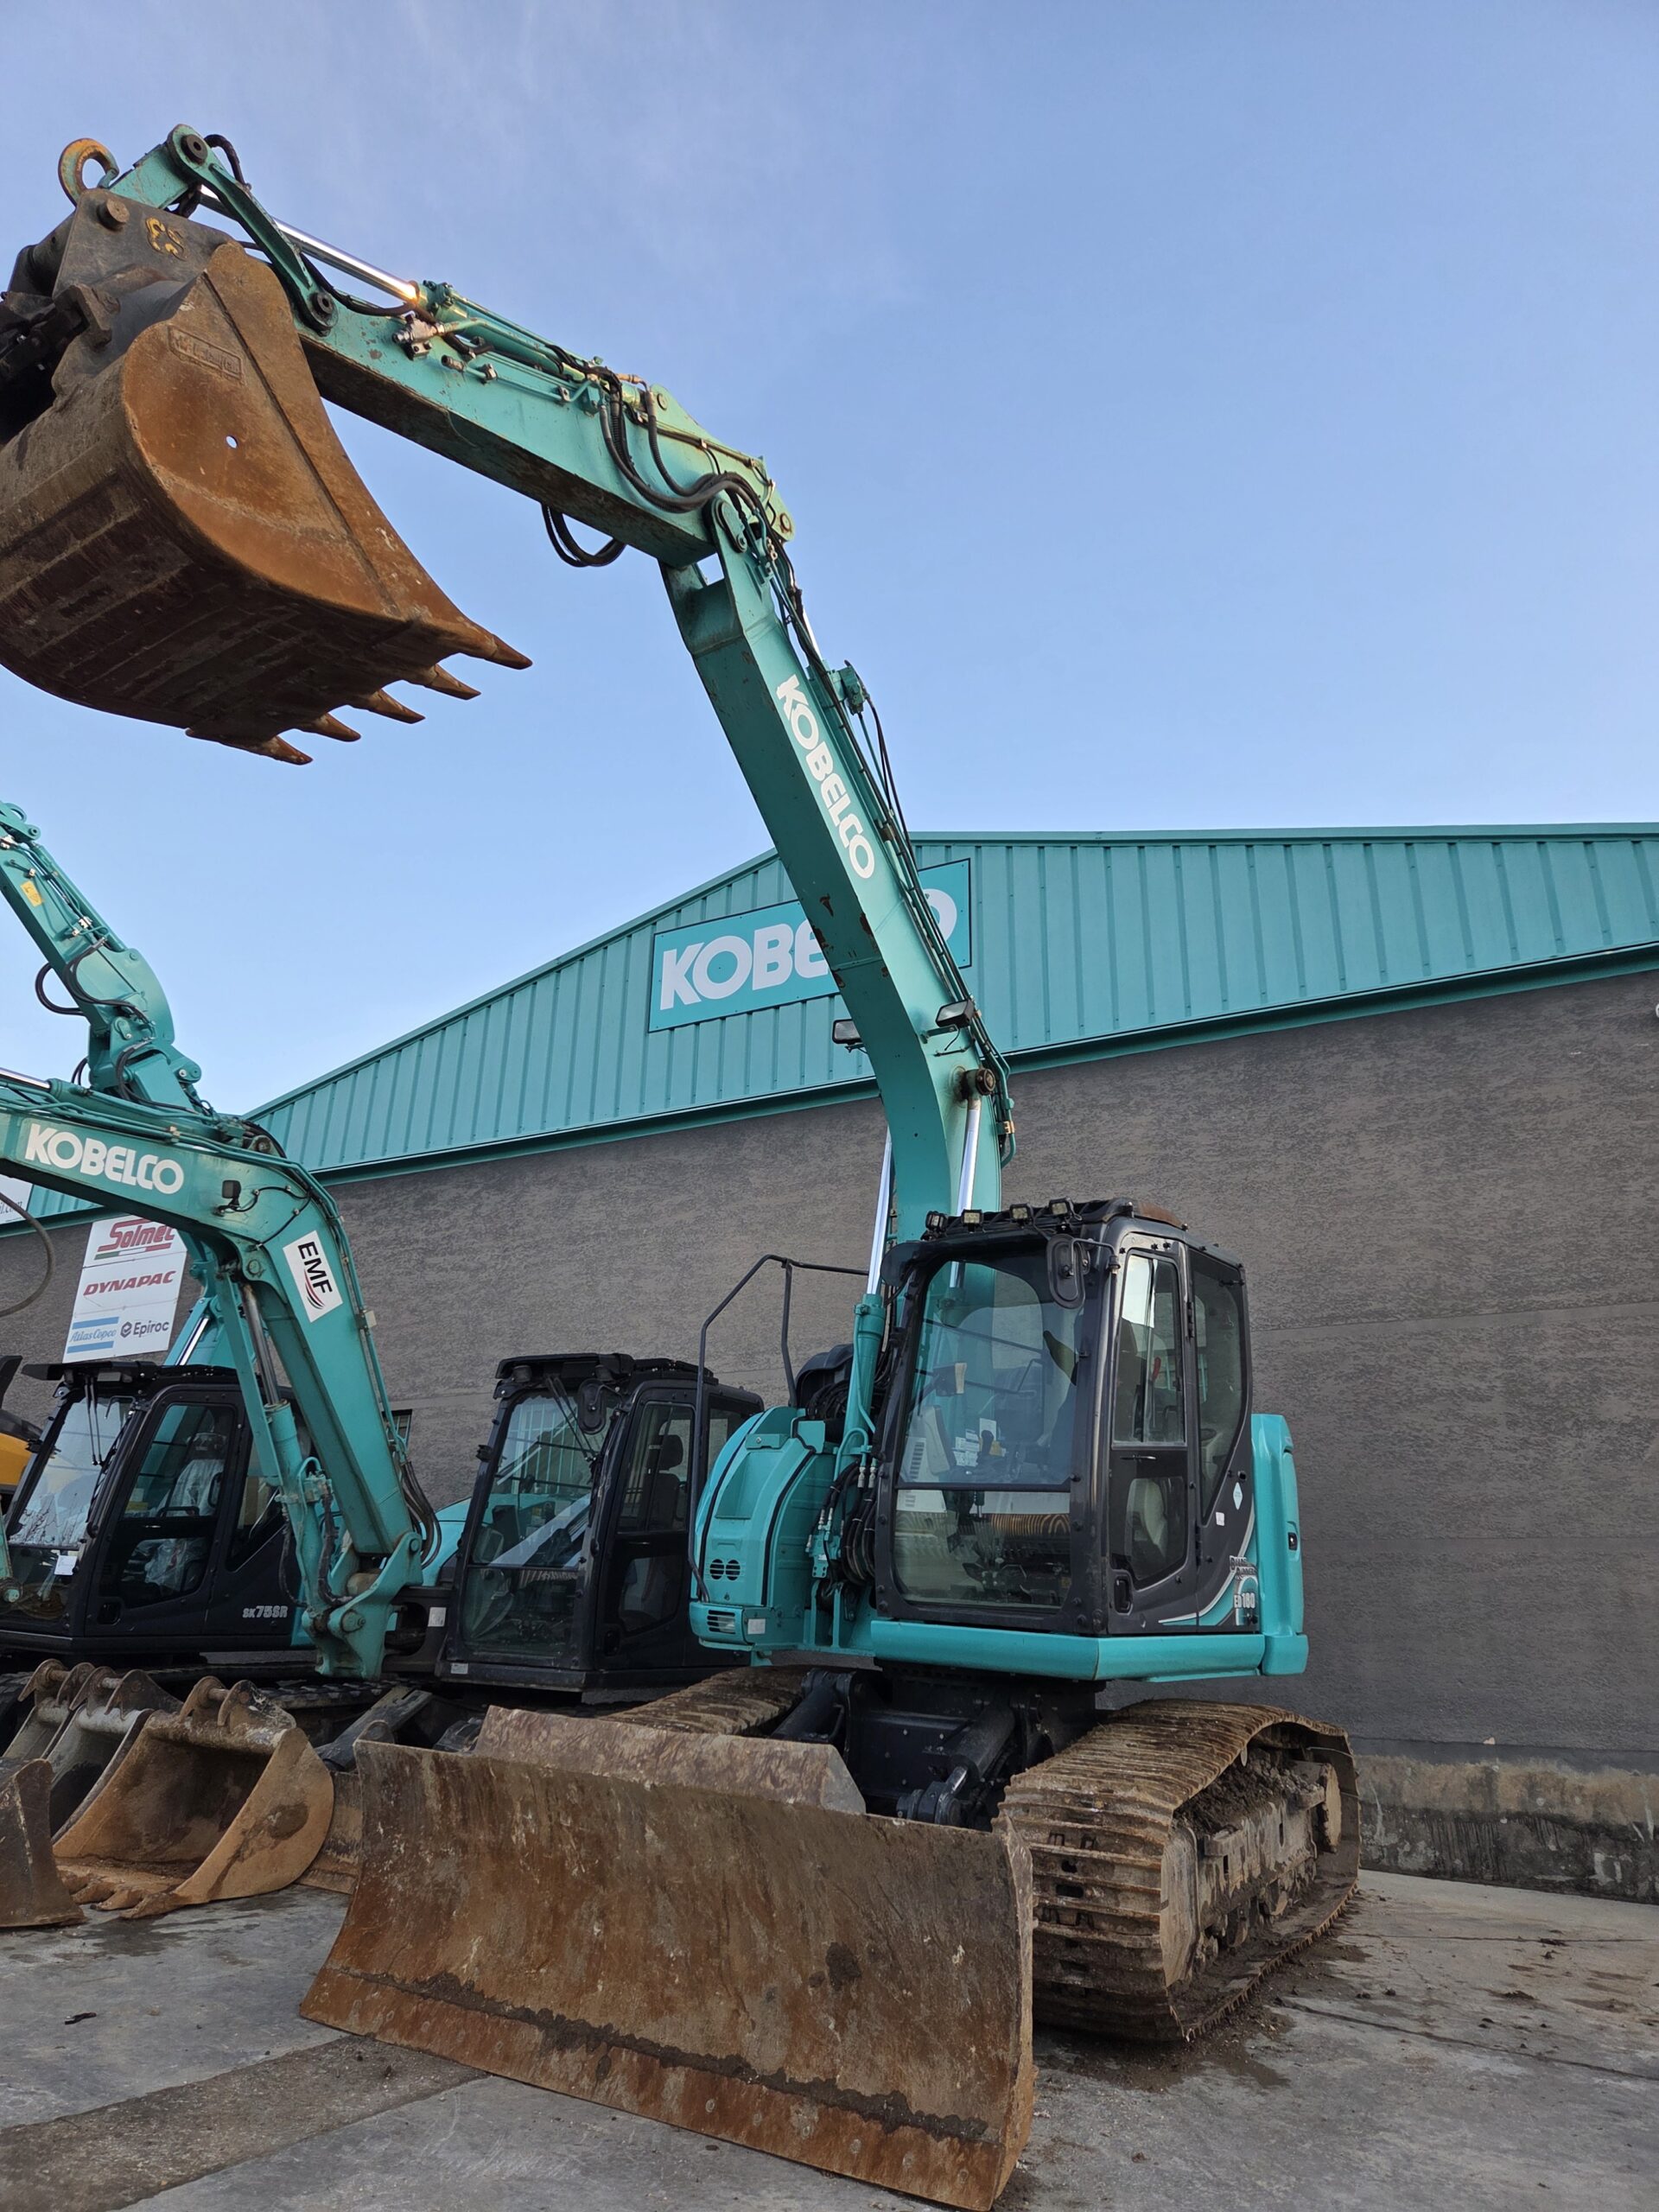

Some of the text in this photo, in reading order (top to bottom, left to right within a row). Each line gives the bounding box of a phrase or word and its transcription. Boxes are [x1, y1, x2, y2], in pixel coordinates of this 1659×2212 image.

[777, 674, 874, 879] KOBELCO
[660, 888, 957, 1010] KOBE
[25, 1123, 184, 1194] KOBELCO
[97, 1218, 175, 1252] Solmec
[83, 1270, 176, 1296] DYNAPAC
[298, 1241, 333, 1293] EMF
[133, 1319, 169, 1338] Epiroc
